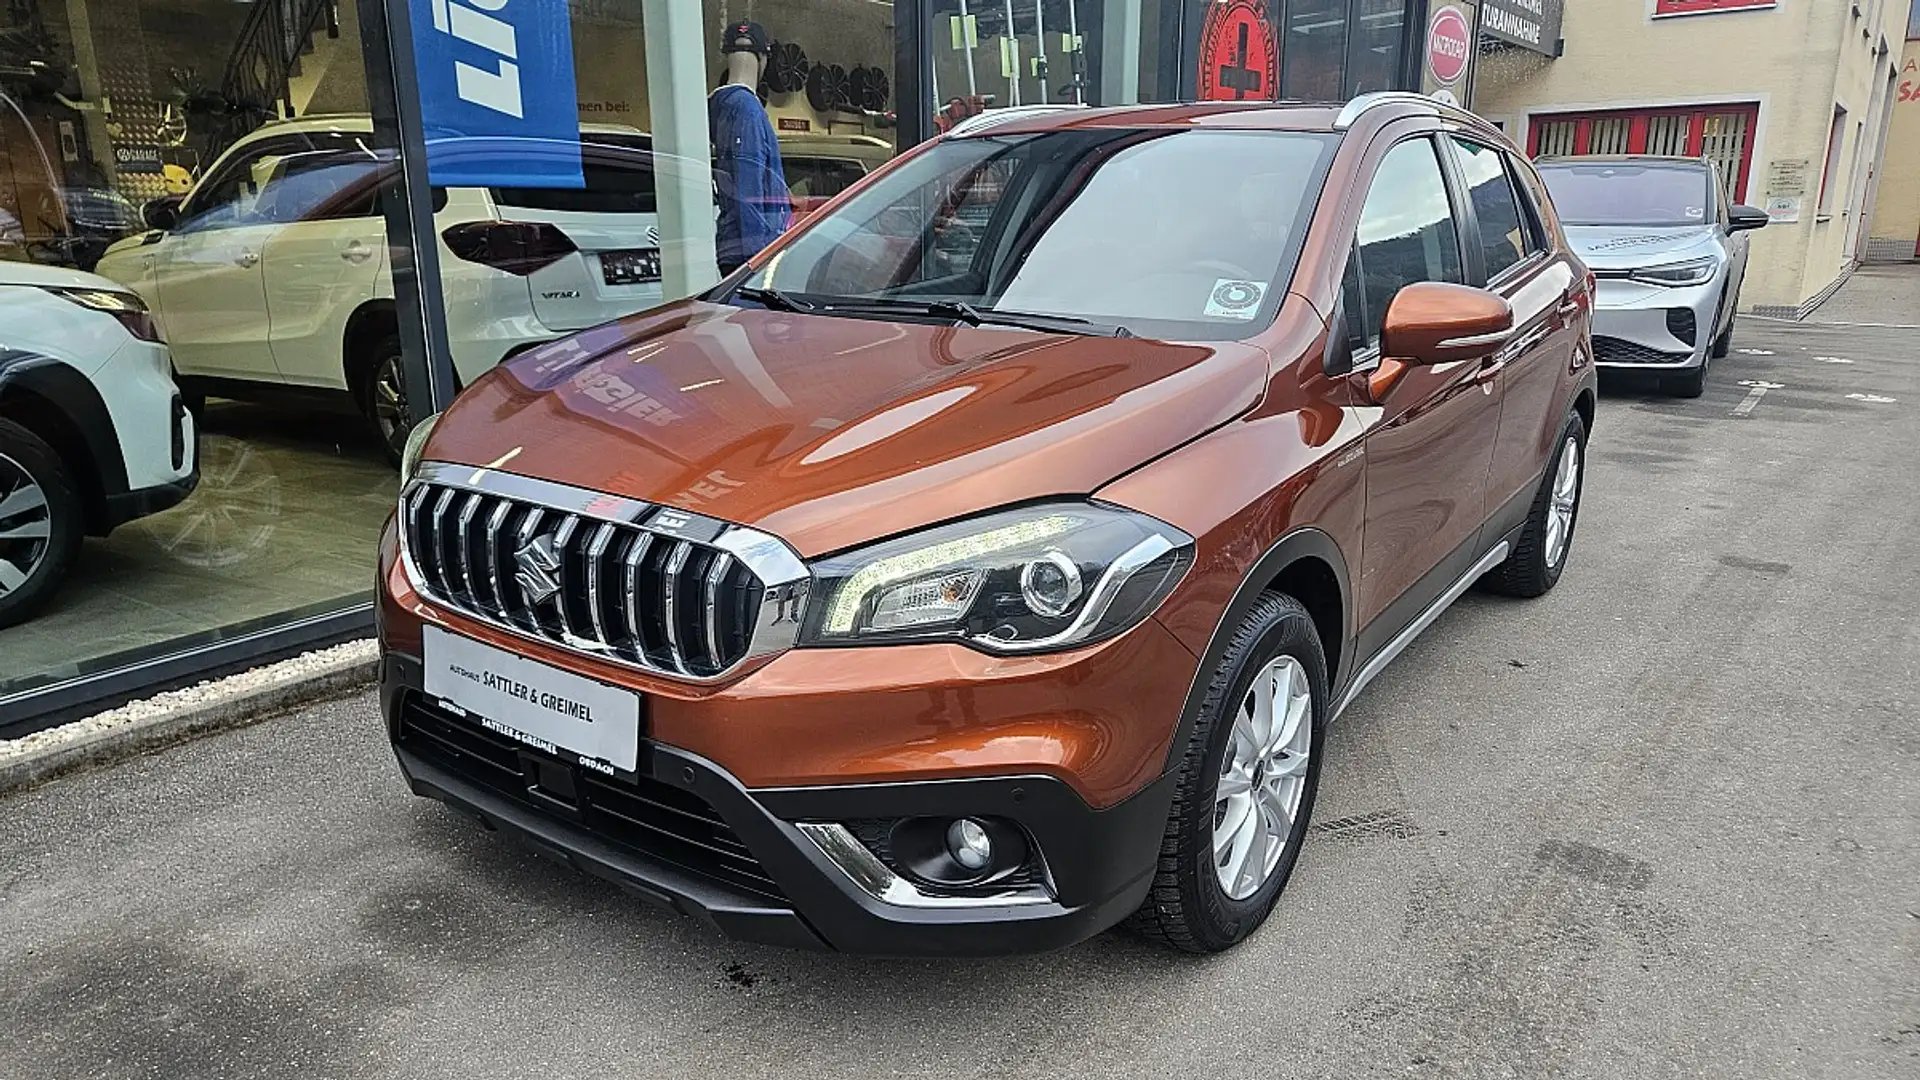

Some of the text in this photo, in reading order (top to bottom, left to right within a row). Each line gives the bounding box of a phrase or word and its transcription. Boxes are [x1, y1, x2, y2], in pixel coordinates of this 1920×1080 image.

[1433, 34, 1465, 60] MICROCAR
[541, 290, 580, 299] VITARA
[449, 663, 593, 723] AUTOHAUS SATTLER & GREIMEL
[481, 718, 514, 738] SATTLER
[521, 732, 558, 756] GREIMEL
